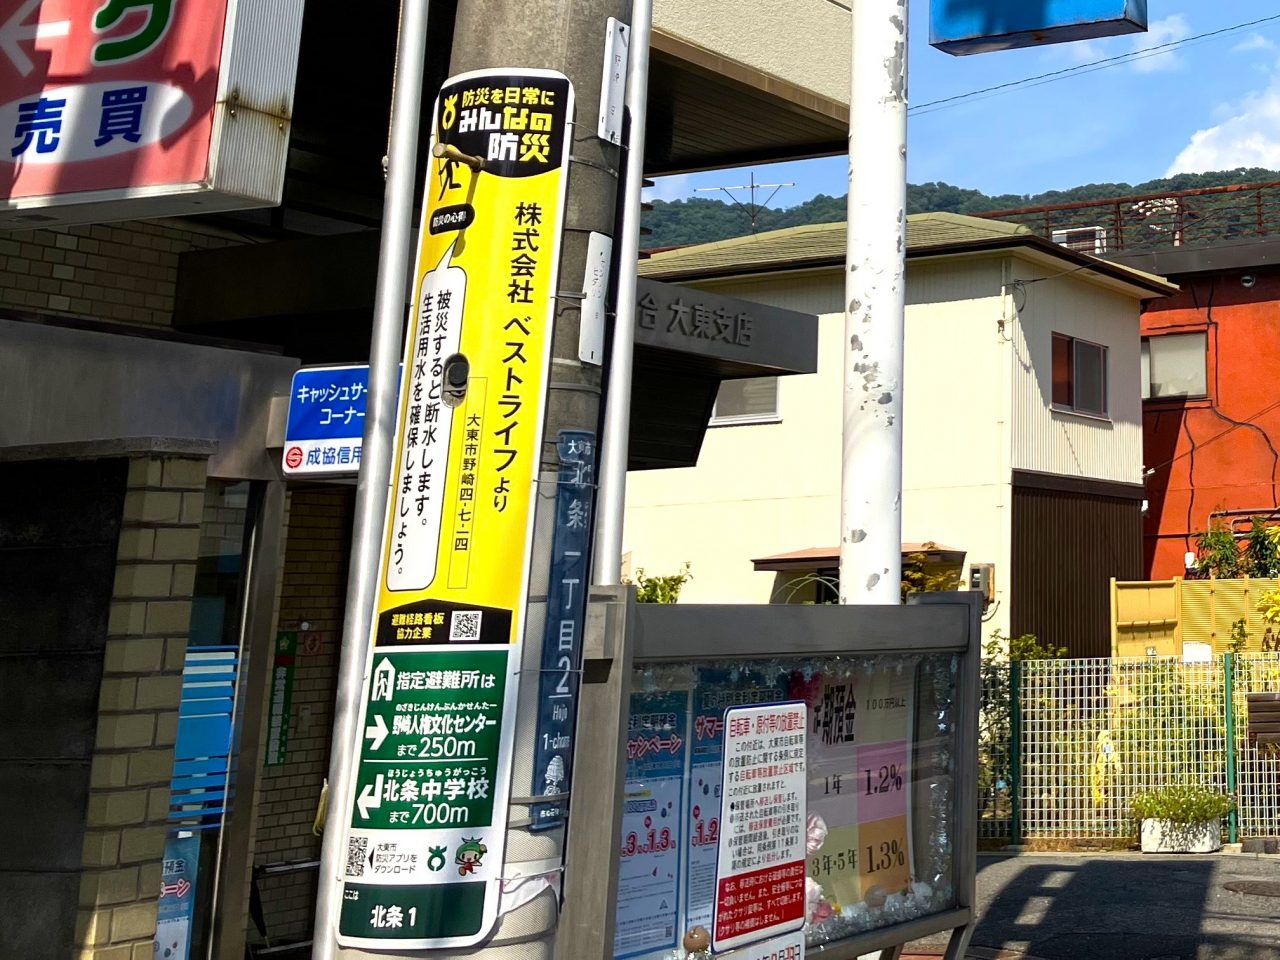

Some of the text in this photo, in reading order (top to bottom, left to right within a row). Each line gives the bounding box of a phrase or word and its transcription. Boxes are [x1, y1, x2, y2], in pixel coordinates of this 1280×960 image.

[461, 86, 556, 108] 防災を日常に
[11, 86, 149, 158] 売買
[458, 106, 553, 134] みんなの
[487, 132, 551, 163] 防災
[492, 201, 542, 513] 株式会社 ベストライフより
[319, 406, 366, 425] コーナー
[415, 289, 453, 527] 被災すると断水します。
[394, 293, 434, 576] 生活用水を確保しましょう。
[396, 626, 433, 640] 協力企業
[396, 670, 496, 690] 指定避難所は
[391, 712, 497, 736] 野崎人権文化センター
[396, 736, 477, 757] まで250m
[387, 766, 488, 778] ほうじょうちゅうがっこう
[382, 776, 490, 802] 北条中学校
[389, 802, 469, 824] まで700m
[375, 853, 418, 863] 防災アプリを
[377, 843, 397, 852] 大東市
[866, 838, 906, 874] 1.3%
[374, 864, 417, 874] ダウンロード
